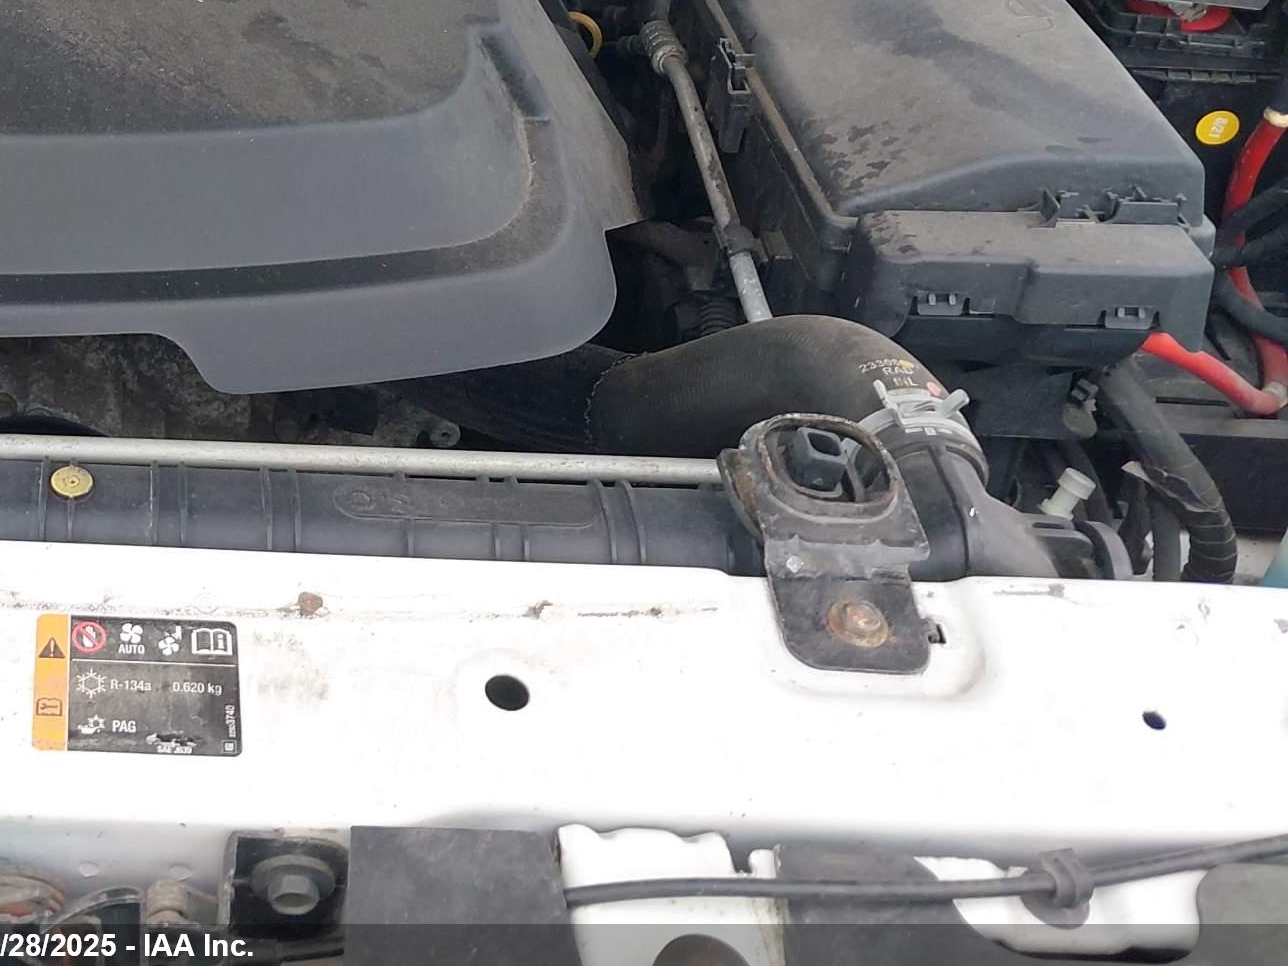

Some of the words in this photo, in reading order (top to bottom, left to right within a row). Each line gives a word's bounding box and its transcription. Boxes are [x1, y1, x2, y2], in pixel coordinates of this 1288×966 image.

[118, 644, 145, 654] AUTO
[110, 679, 152, 692] R-134a
[172, 680, 204, 693] 0.620
[207, 682, 223, 696] kg
[112, 720, 137, 733] PAG
